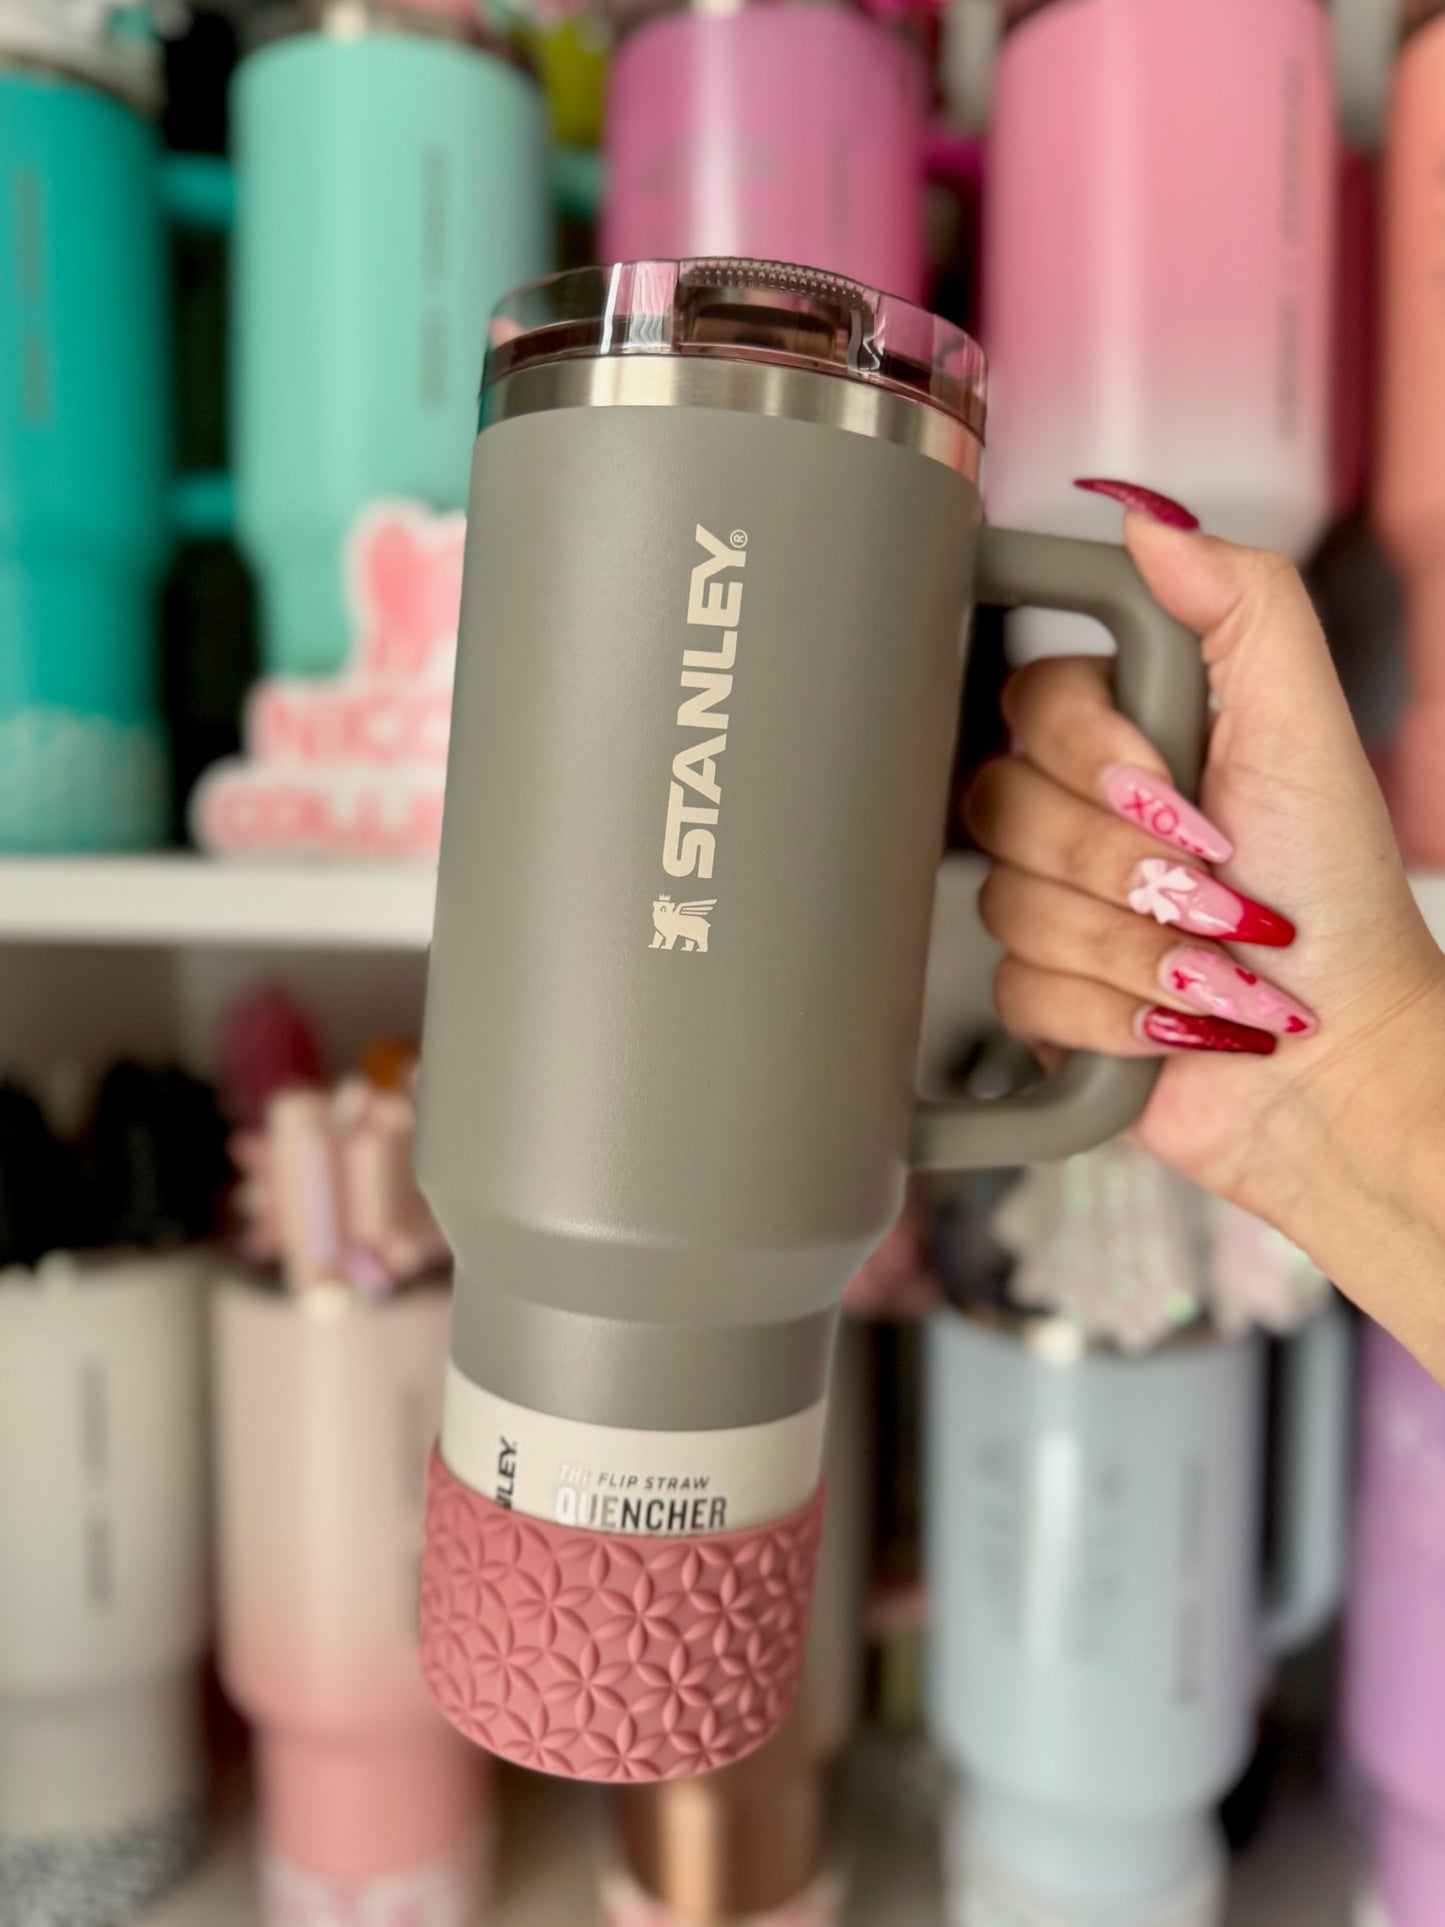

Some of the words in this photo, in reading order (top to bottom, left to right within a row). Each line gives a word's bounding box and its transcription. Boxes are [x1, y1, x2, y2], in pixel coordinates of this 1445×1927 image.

[598, 1472, 638, 1489] FLIP
[644, 1475, 711, 1491] STRAW
[555, 1486, 727, 1531] QUENCHER
